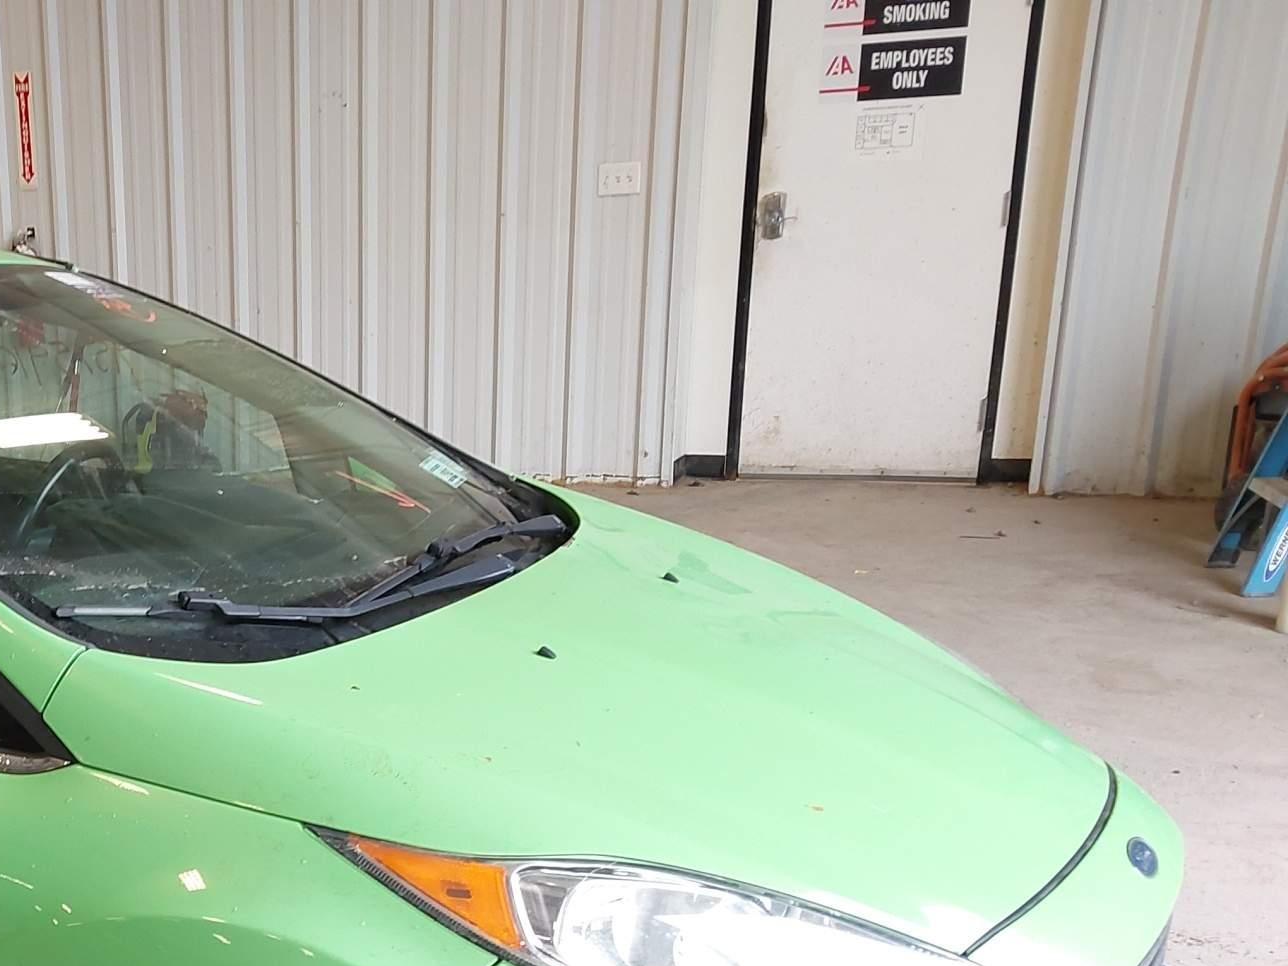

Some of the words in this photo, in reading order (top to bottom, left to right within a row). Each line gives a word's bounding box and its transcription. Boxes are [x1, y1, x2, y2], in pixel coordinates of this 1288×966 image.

[883, 1, 950, 24] SMOKING
[870, 46, 954, 70] EMPLOYEES
[892, 69, 928, 90] ONLY
